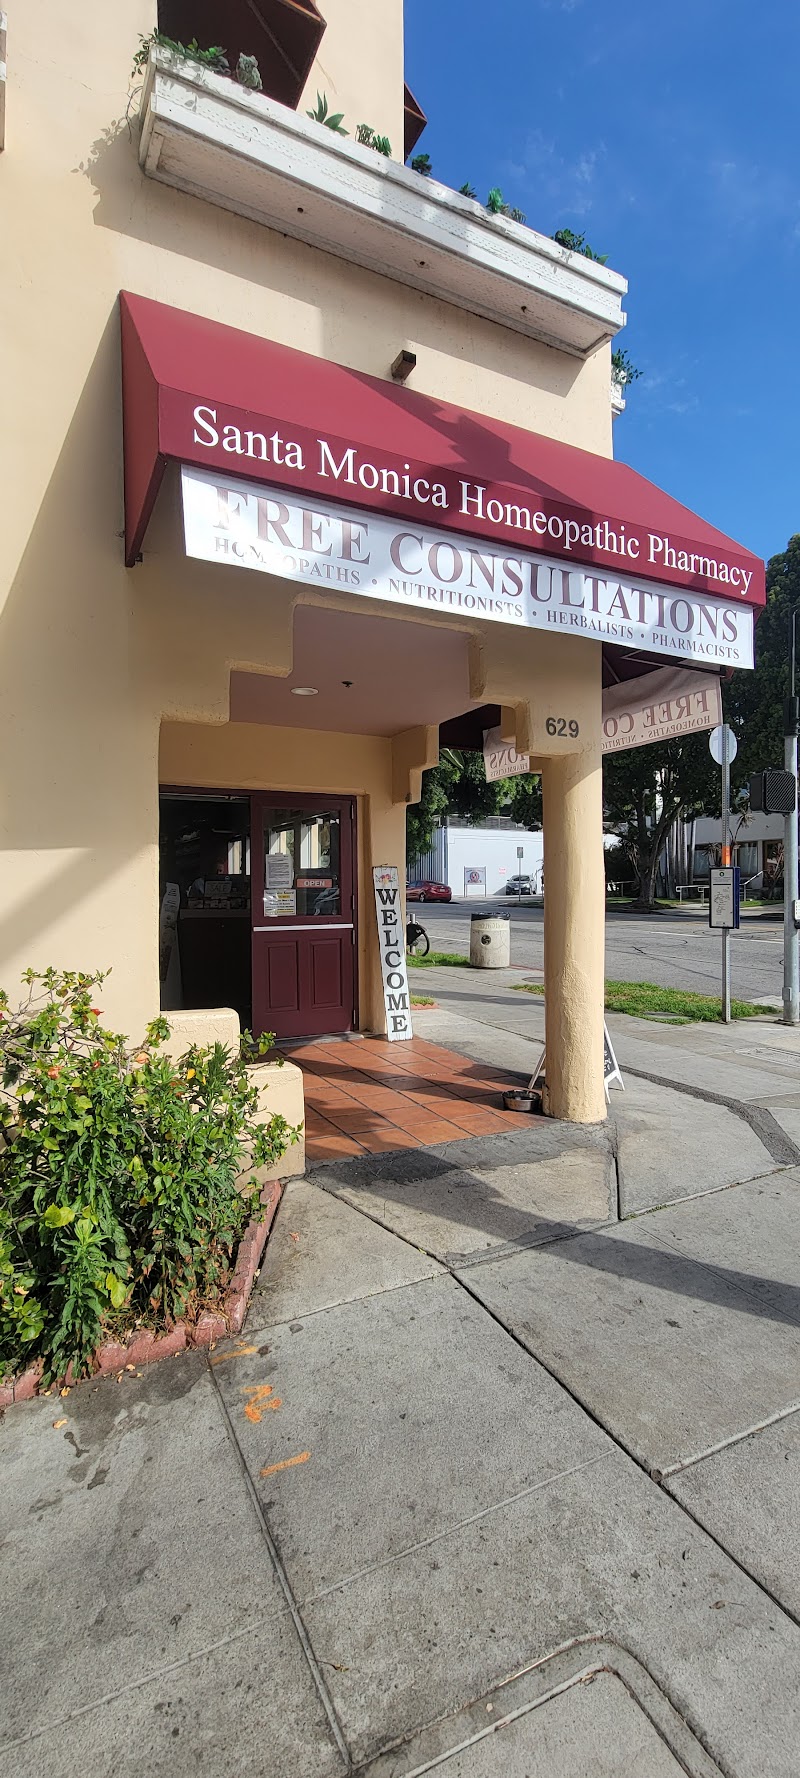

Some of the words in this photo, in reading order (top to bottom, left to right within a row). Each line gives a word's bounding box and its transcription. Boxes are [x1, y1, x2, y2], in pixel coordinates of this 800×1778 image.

[193, 405, 306, 470] Santa
[316, 439, 449, 509] Monica
[458, 480, 640, 559] Homeopathic
[647, 533, 753, 595] Pharmacy
[212, 486, 371, 566] FREE
[389, 532, 739, 643] CONSULTATIONS
[388, 578, 523, 617] NUTRITIONISTS
[547, 610, 634, 640] HERBALISTS
[652, 633, 740, 660] PHARMACISTS
[545, 717, 580, 739] 629
[375, 888, 409, 1034] WELCOME
